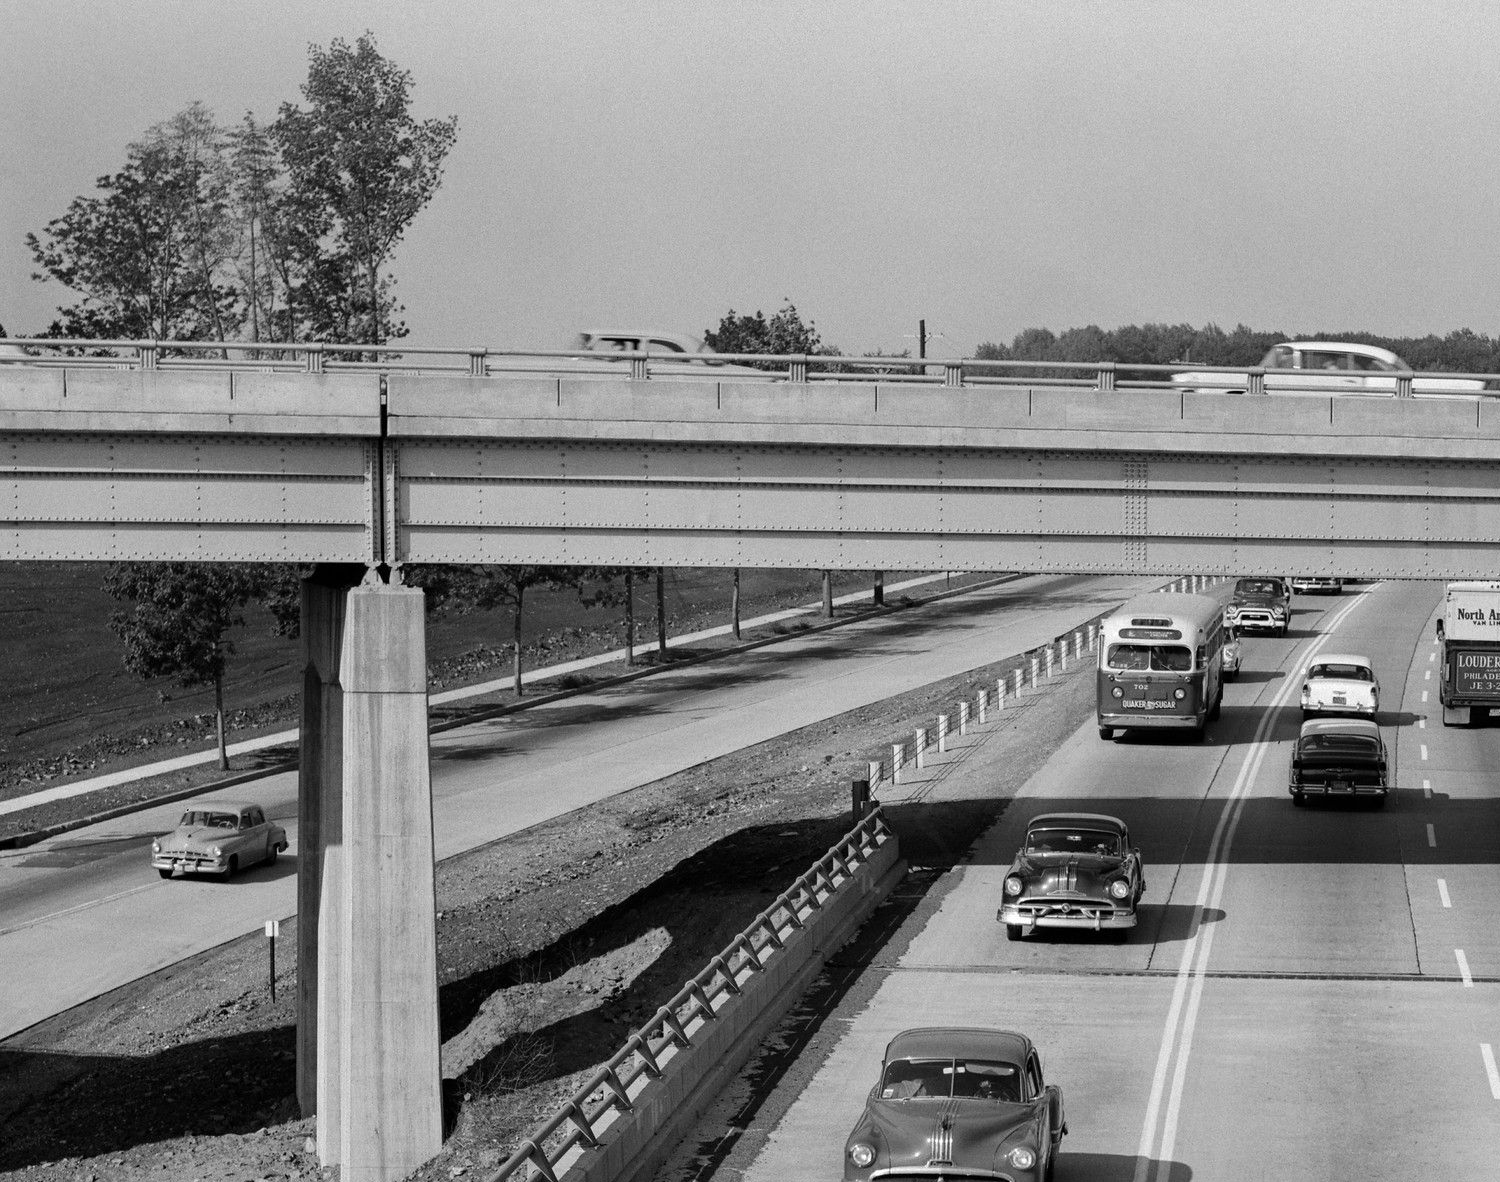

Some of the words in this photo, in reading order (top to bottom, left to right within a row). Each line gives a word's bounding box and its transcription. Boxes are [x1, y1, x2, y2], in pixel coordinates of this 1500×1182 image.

[1458, 608, 1485, 621] North
[1470, 682, 1483, 690] JE
[1122, 700, 1146, 709] QUAKER
[1155, 701, 1176, 709] SUGAR
